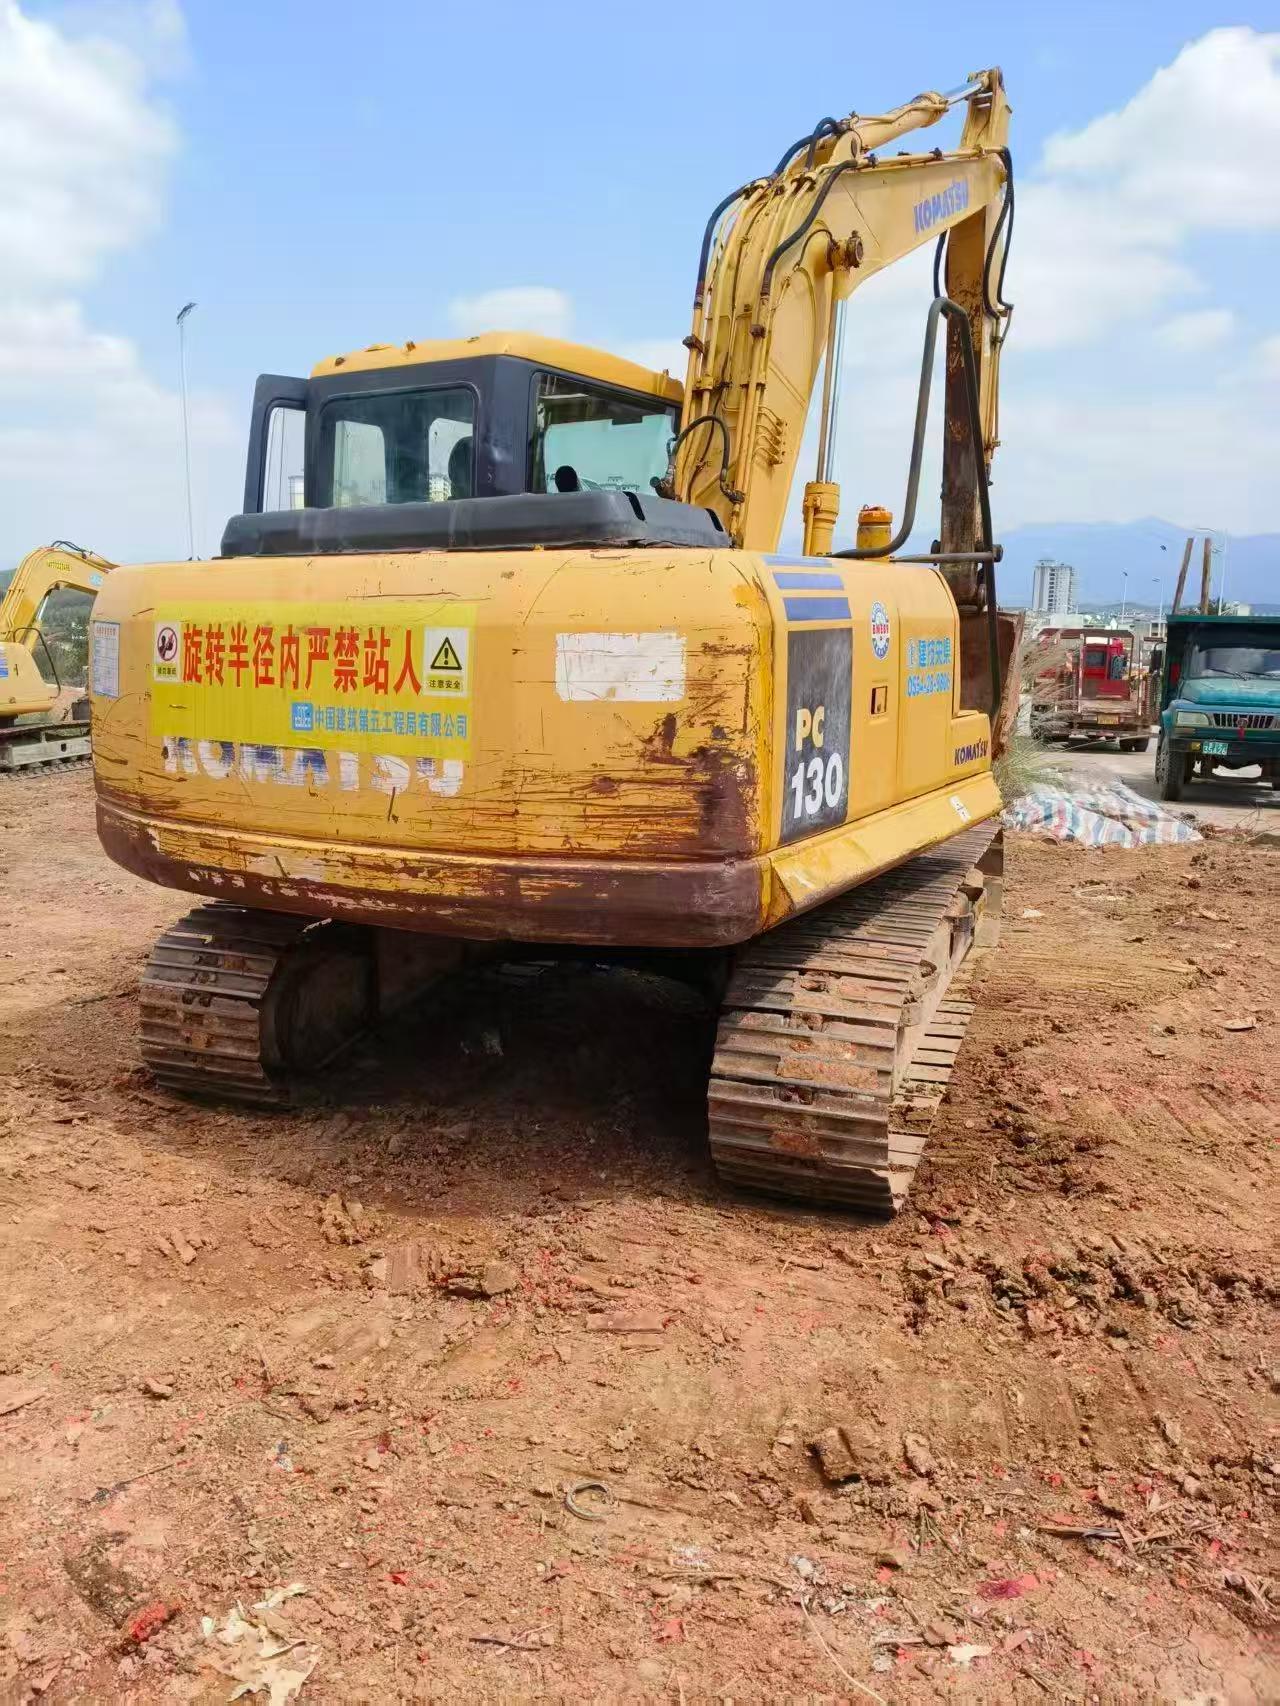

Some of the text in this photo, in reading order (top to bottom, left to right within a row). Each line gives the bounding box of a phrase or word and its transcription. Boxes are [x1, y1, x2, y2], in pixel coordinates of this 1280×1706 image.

[913, 176, 968, 234] KOMATSU
[183, 622, 421, 696] 旋转半径内严禁站人
[429, 679, 461, 689] 注意安全
[315, 705, 467, 739] 中国建筑第五工程局有限公司
[796, 706, 825, 752] PC
[954, 738, 988, 766] KOMATSU
[791, 752, 843, 819] 130
